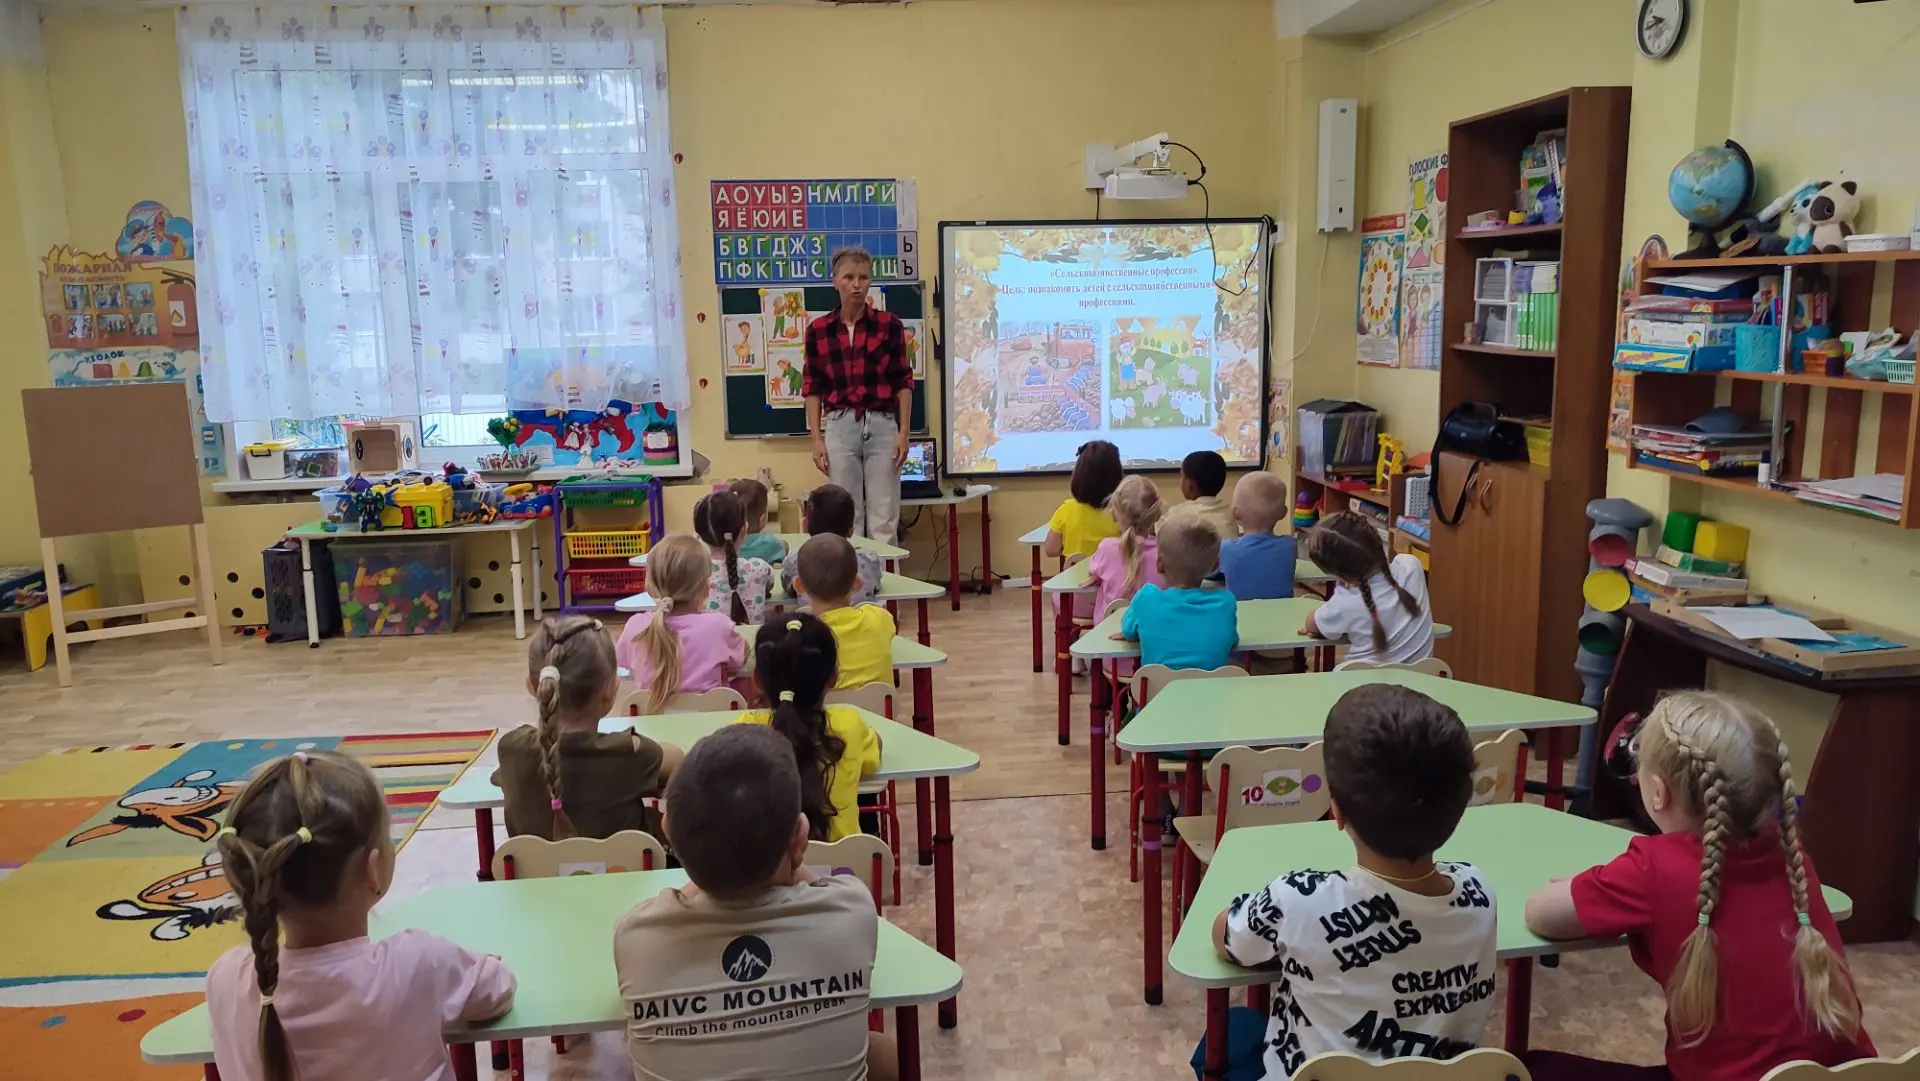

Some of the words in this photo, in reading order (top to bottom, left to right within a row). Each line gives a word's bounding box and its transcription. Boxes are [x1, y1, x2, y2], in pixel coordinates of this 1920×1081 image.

[1409, 155, 1439, 176] ПЛОСКИЕ
[1028, 284, 1081, 294] познакомить
[1082, 283, 1105, 293] детей
[1241, 785, 1264, 805] 10
[1332, 919, 1422, 973] STREET
[1392, 961, 1480, 994] CREATIVE
[633, 996, 708, 1021] DAIVC
[723, 969, 863, 1011] MOUNTAIN
[655, 1023, 698, 1037] Climb
[702, 1021, 728, 1035] the
[733, 1004, 809, 1030] mountain
[814, 997, 846, 1015] peak
